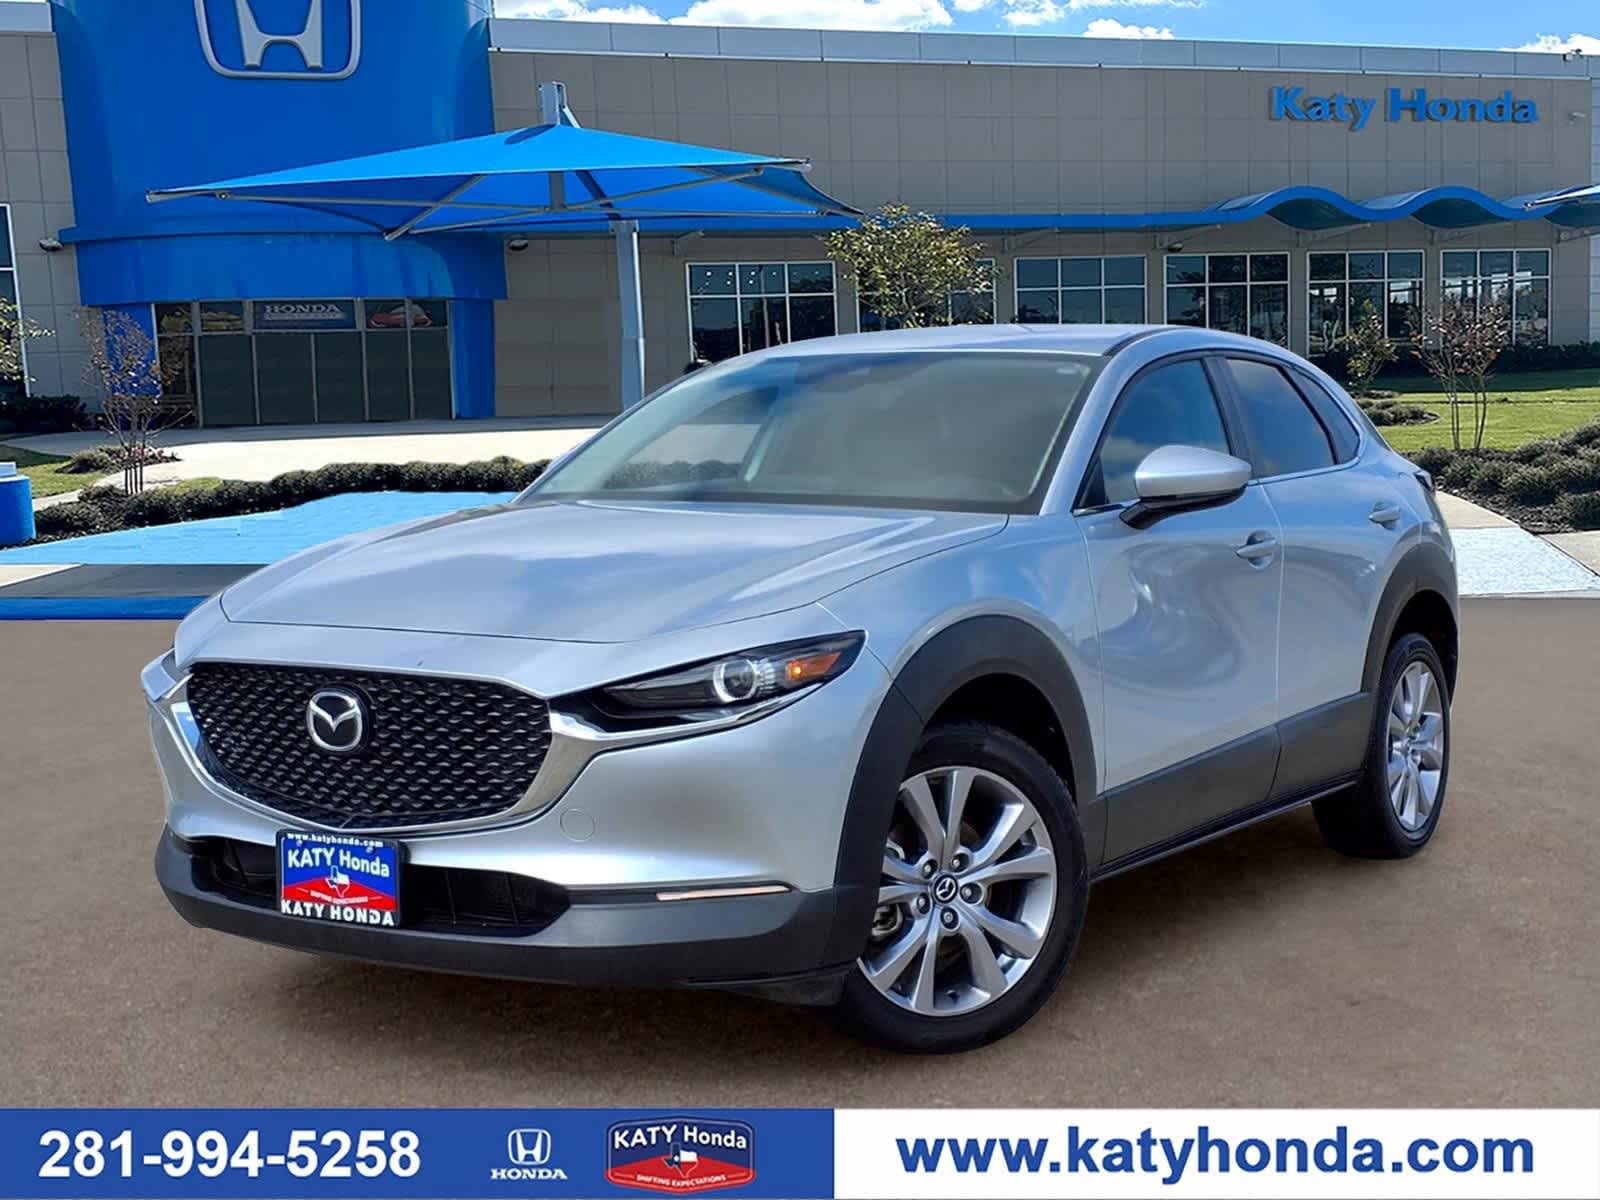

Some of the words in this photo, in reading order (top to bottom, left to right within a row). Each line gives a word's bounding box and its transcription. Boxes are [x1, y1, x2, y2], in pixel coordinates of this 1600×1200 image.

[1270, 86, 1376, 132] Katy
[1384, 87, 1540, 124] Honda
[265, 304, 341, 313] HONDA
[287, 833, 383, 847] www.katyhonda.com
[288, 847, 335, 868] KATY
[339, 849, 390, 877] Honda
[281, 899, 325, 918] KATY
[330, 904, 394, 926] HONDA
